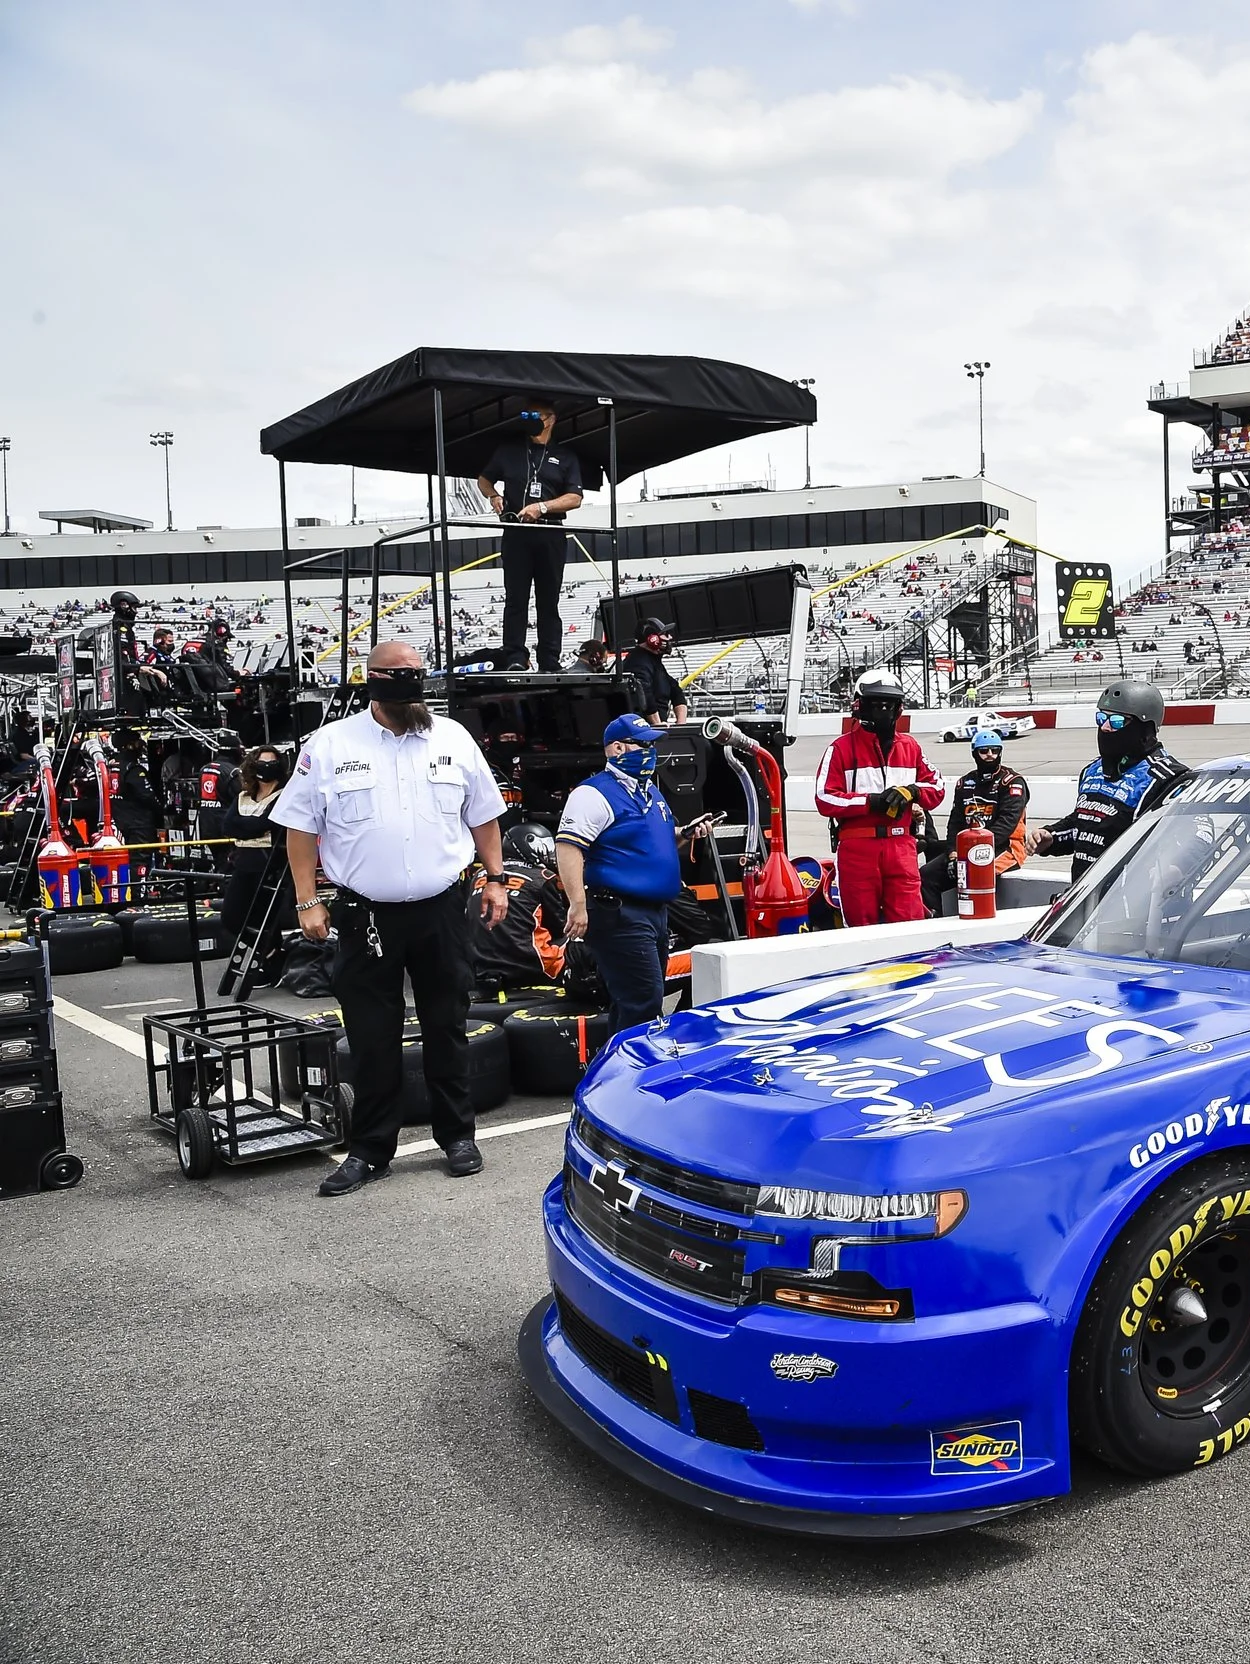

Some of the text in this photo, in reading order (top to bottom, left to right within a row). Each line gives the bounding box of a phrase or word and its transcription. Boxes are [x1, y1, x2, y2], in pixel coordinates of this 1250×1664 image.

[1063, 578, 1109, 626] 2
[335, 763, 371, 775] OFFICIAL
[670, 1249, 714, 1272] RST
[770, 1354, 798, 1368] Jordan
[787, 1366, 814, 1380] Racing
[939, 1442, 1018, 1460] SUNOCO
